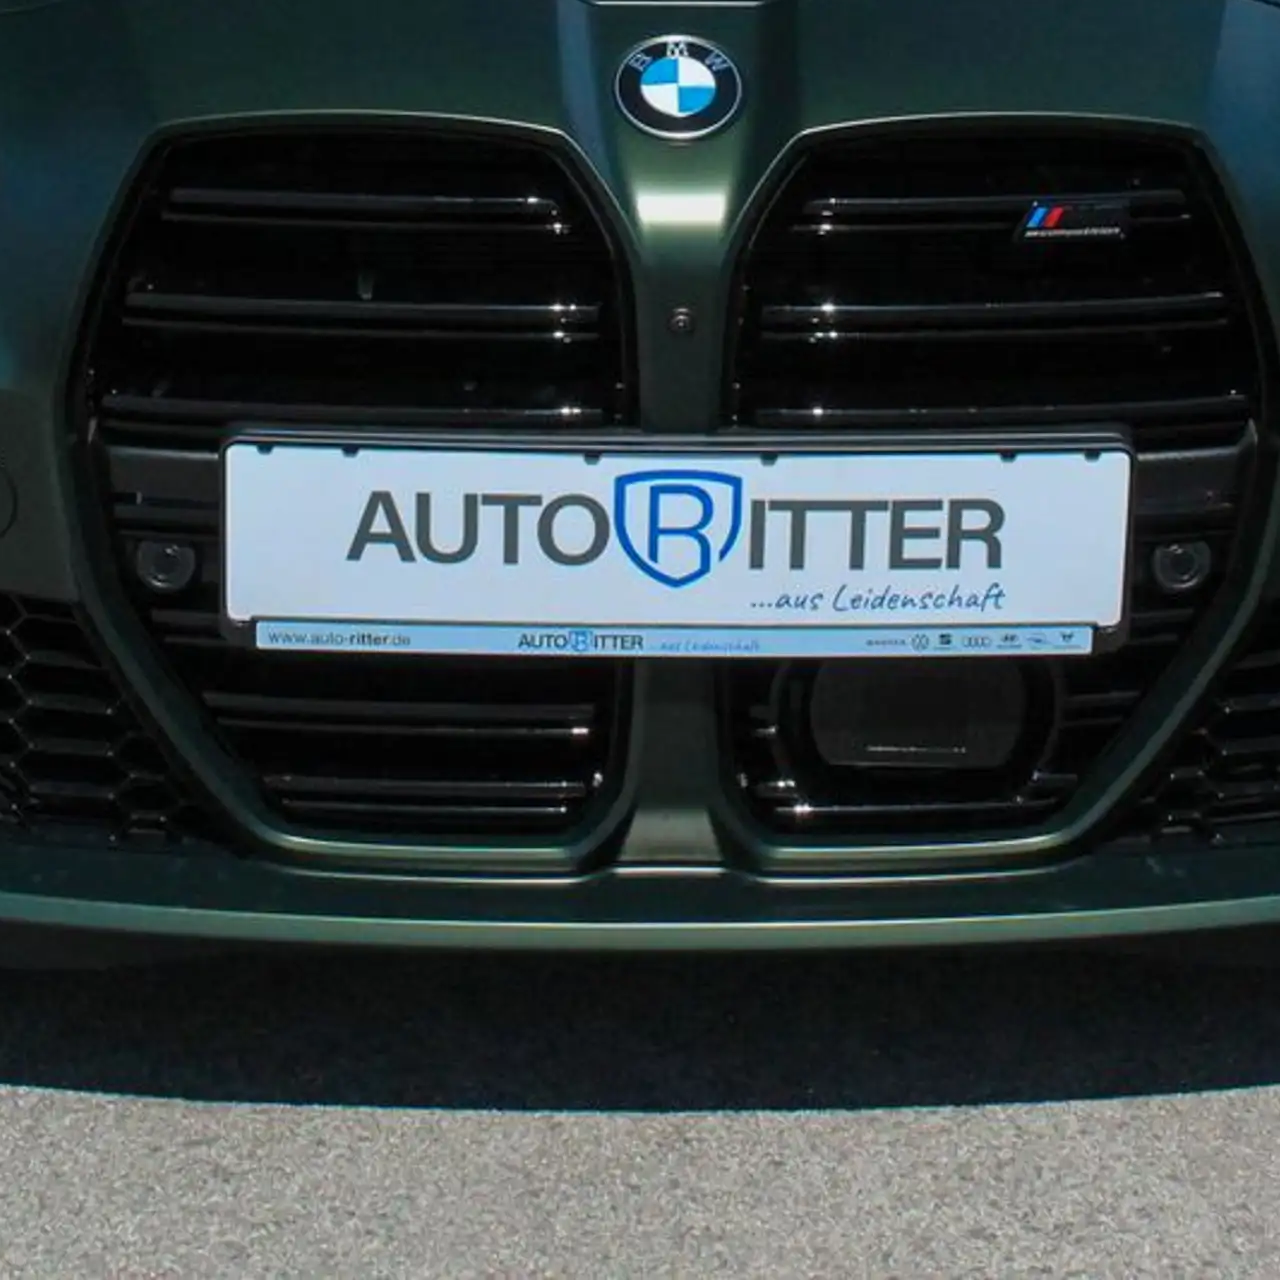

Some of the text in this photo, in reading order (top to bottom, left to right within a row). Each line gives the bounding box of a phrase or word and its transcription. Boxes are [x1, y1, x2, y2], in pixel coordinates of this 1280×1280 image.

[629, 40, 730, 72] BMW
[832, 581, 1007, 613] Leidenschaft
[267, 629, 413, 648] www.auto-ritter.de
